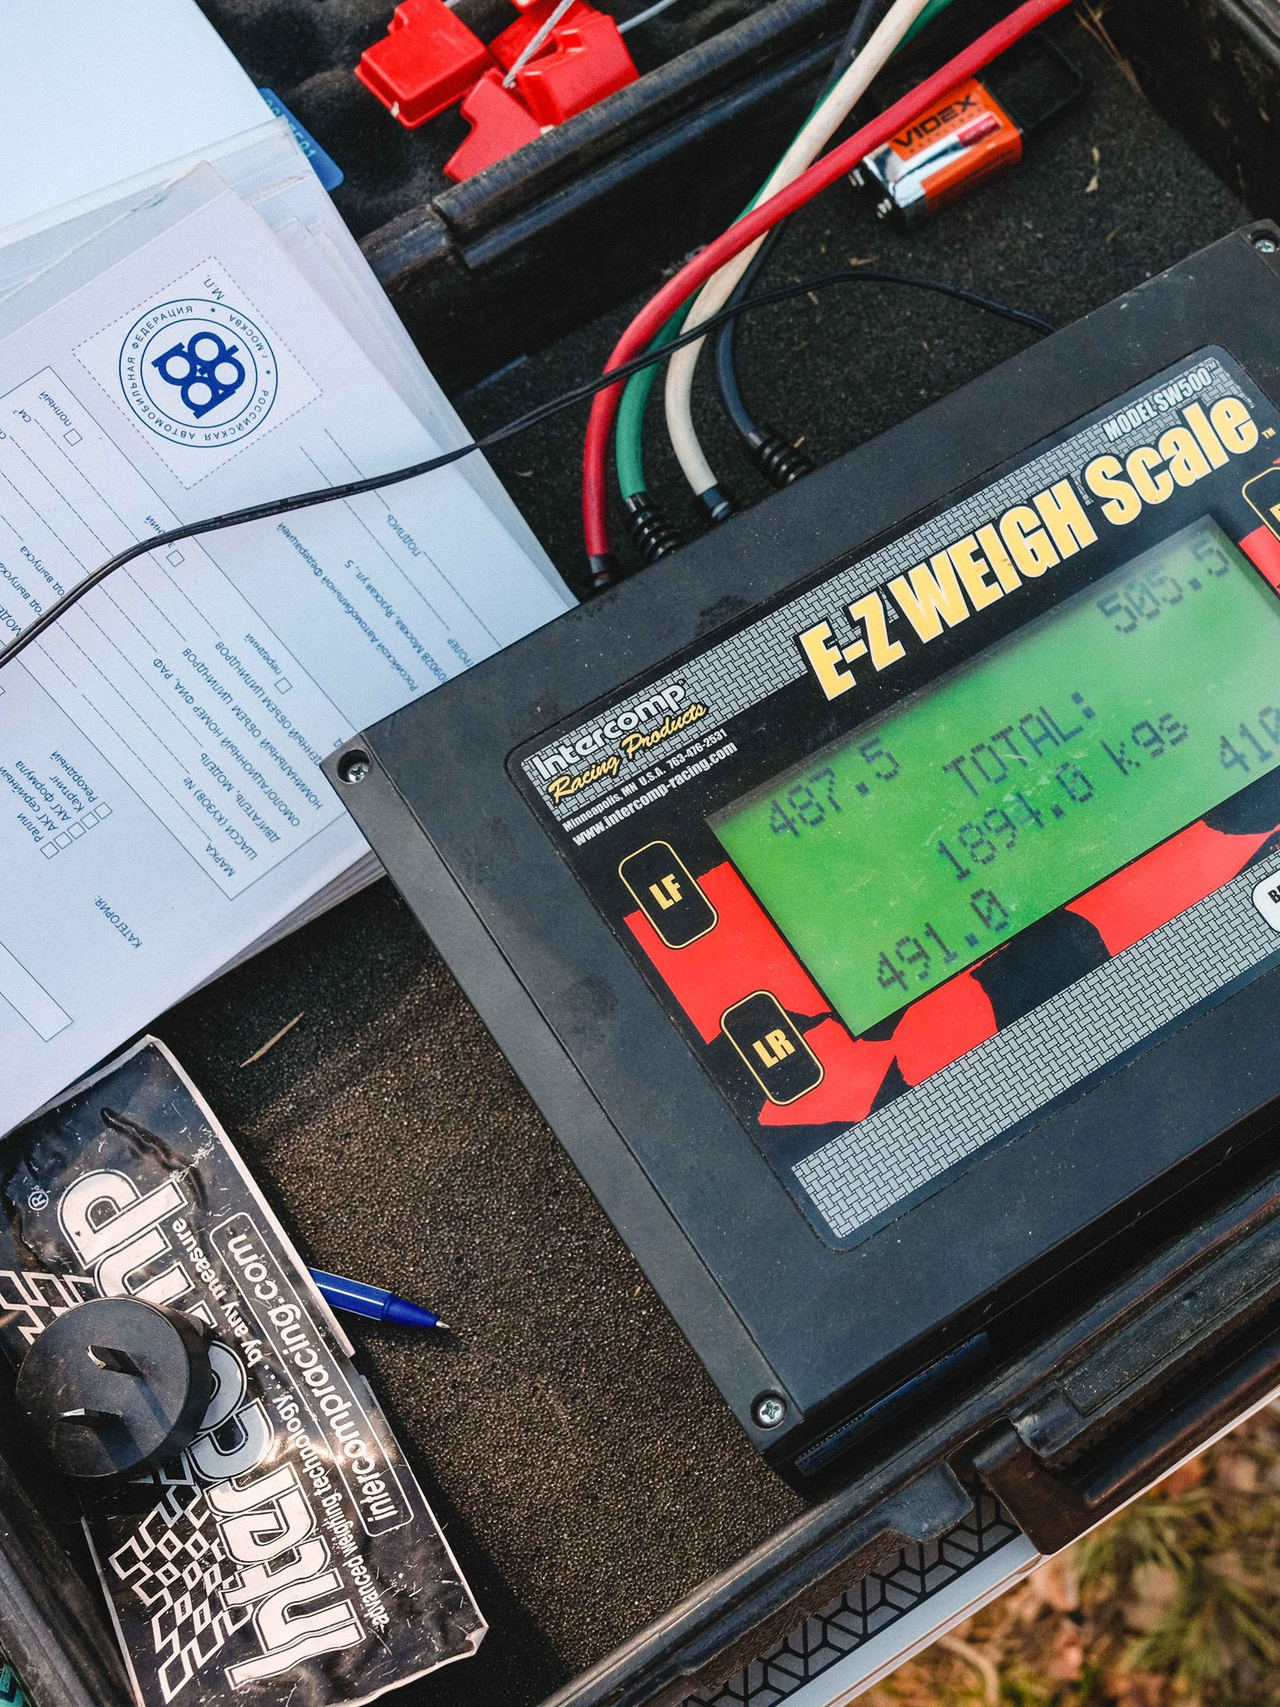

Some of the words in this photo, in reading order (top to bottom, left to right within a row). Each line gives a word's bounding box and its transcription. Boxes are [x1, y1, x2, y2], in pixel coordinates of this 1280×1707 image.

[894, 95, 977, 147] VIDEX
[201, 275, 225, 304] М.П.
[131, 305, 194, 350] ФЕДЕРАЦИЯ
[37, 390, 73, 427] полный
[126, 356, 196, 439] АВТОМОБИЛЬНАЯ
[203, 389, 270, 442] РОССИЙСКАЯ
[1101, 397, 1158, 442] MODEL
[1152, 365, 1214, 413] SW500
[142, 512, 177, 551] зний
[276, 521, 324, 578] Федерацией
[386, 513, 422, 557] ПОДПИСЬ
[798, 588, 907, 701] E-Z
[888, 477, 1098, 643] WEIGH
[1084, 395, 1259, 527] Scale
[19, 545, 55, 584] выпуска
[343, 559, 355, 569] 5
[320, 575, 380, 644] Автомобильной
[364, 582, 396, 619] Яузская
[243, 632, 283, 676] передний
[395, 615, 425, 655] Москва,
[152, 658, 175, 681] РАФ
[182, 647, 234, 706] ЦИЛИНДРОВ
[214, 641, 266, 699] ЦИЛИНДРОВ
[375, 642, 419, 692] Российской
[768, 736, 900, 837] 487.5
[1100, 538, 1233, 636] 505.5
[174, 677, 195, 705] ФИА,
[261, 695, 292, 730] ОБЪЕМ
[192, 706, 224, 739] НОМЕР
[230, 704, 262, 738] ОБЪЕМ
[533, 681, 686, 778] Intercomp
[943, 690, 1095, 797] TOTAL:
[1101, 708, 1190, 777] kgs
[200, 752, 235, 793] МОДЕЛЬ
[544, 751, 621, 804] Racing
[618, 698, 708, 759] Products
[14, 760, 55, 803] формула
[48, 775, 86, 814] Картинг
[49, 750, 99, 804] Рекордный
[183, 776, 197, 791] №
[219, 736, 301, 827] ОМОЛОГАЦИОННЫЙ
[258, 737, 324, 811] НОМИНАЛЬНЫЙ
[561, 789, 624, 833] Minneapolis,
[620, 780, 639, 797] MN
[637, 763, 666, 786] U.S.A.
[665, 727, 728, 770] 763-476-2531
[571, 740, 738, 847] www.intercomp-racing.com
[16, 812, 45, 843] Ралли
[35, 813, 59, 832] АКГ
[49, 803, 73, 822] АКГ
[192, 788, 229, 827] (КУЗОВ)
[235, 789, 282, 844] ДВИГАТЕЛЬ,
[205, 842, 236, 878] МАРКА
[224, 824, 258, 861] ШАССИ
[647, 871, 688, 912] LF
[94, 895, 143, 949] КАТЕГОРИЯ:
[874, 886, 1011, 993] 491.0
[751, 1025, 796, 1068] LR
[168, 1216, 227, 1300] measure
[217, 1299, 248, 1338] any
[236, 1334, 265, 1366] by
[223, 1231, 397, 1525] intercompracing.com
[268, 1393, 332, 1497] technology
[317, 1491, 359, 1557] weighing
[343, 1553, 390, 1627] advanced
